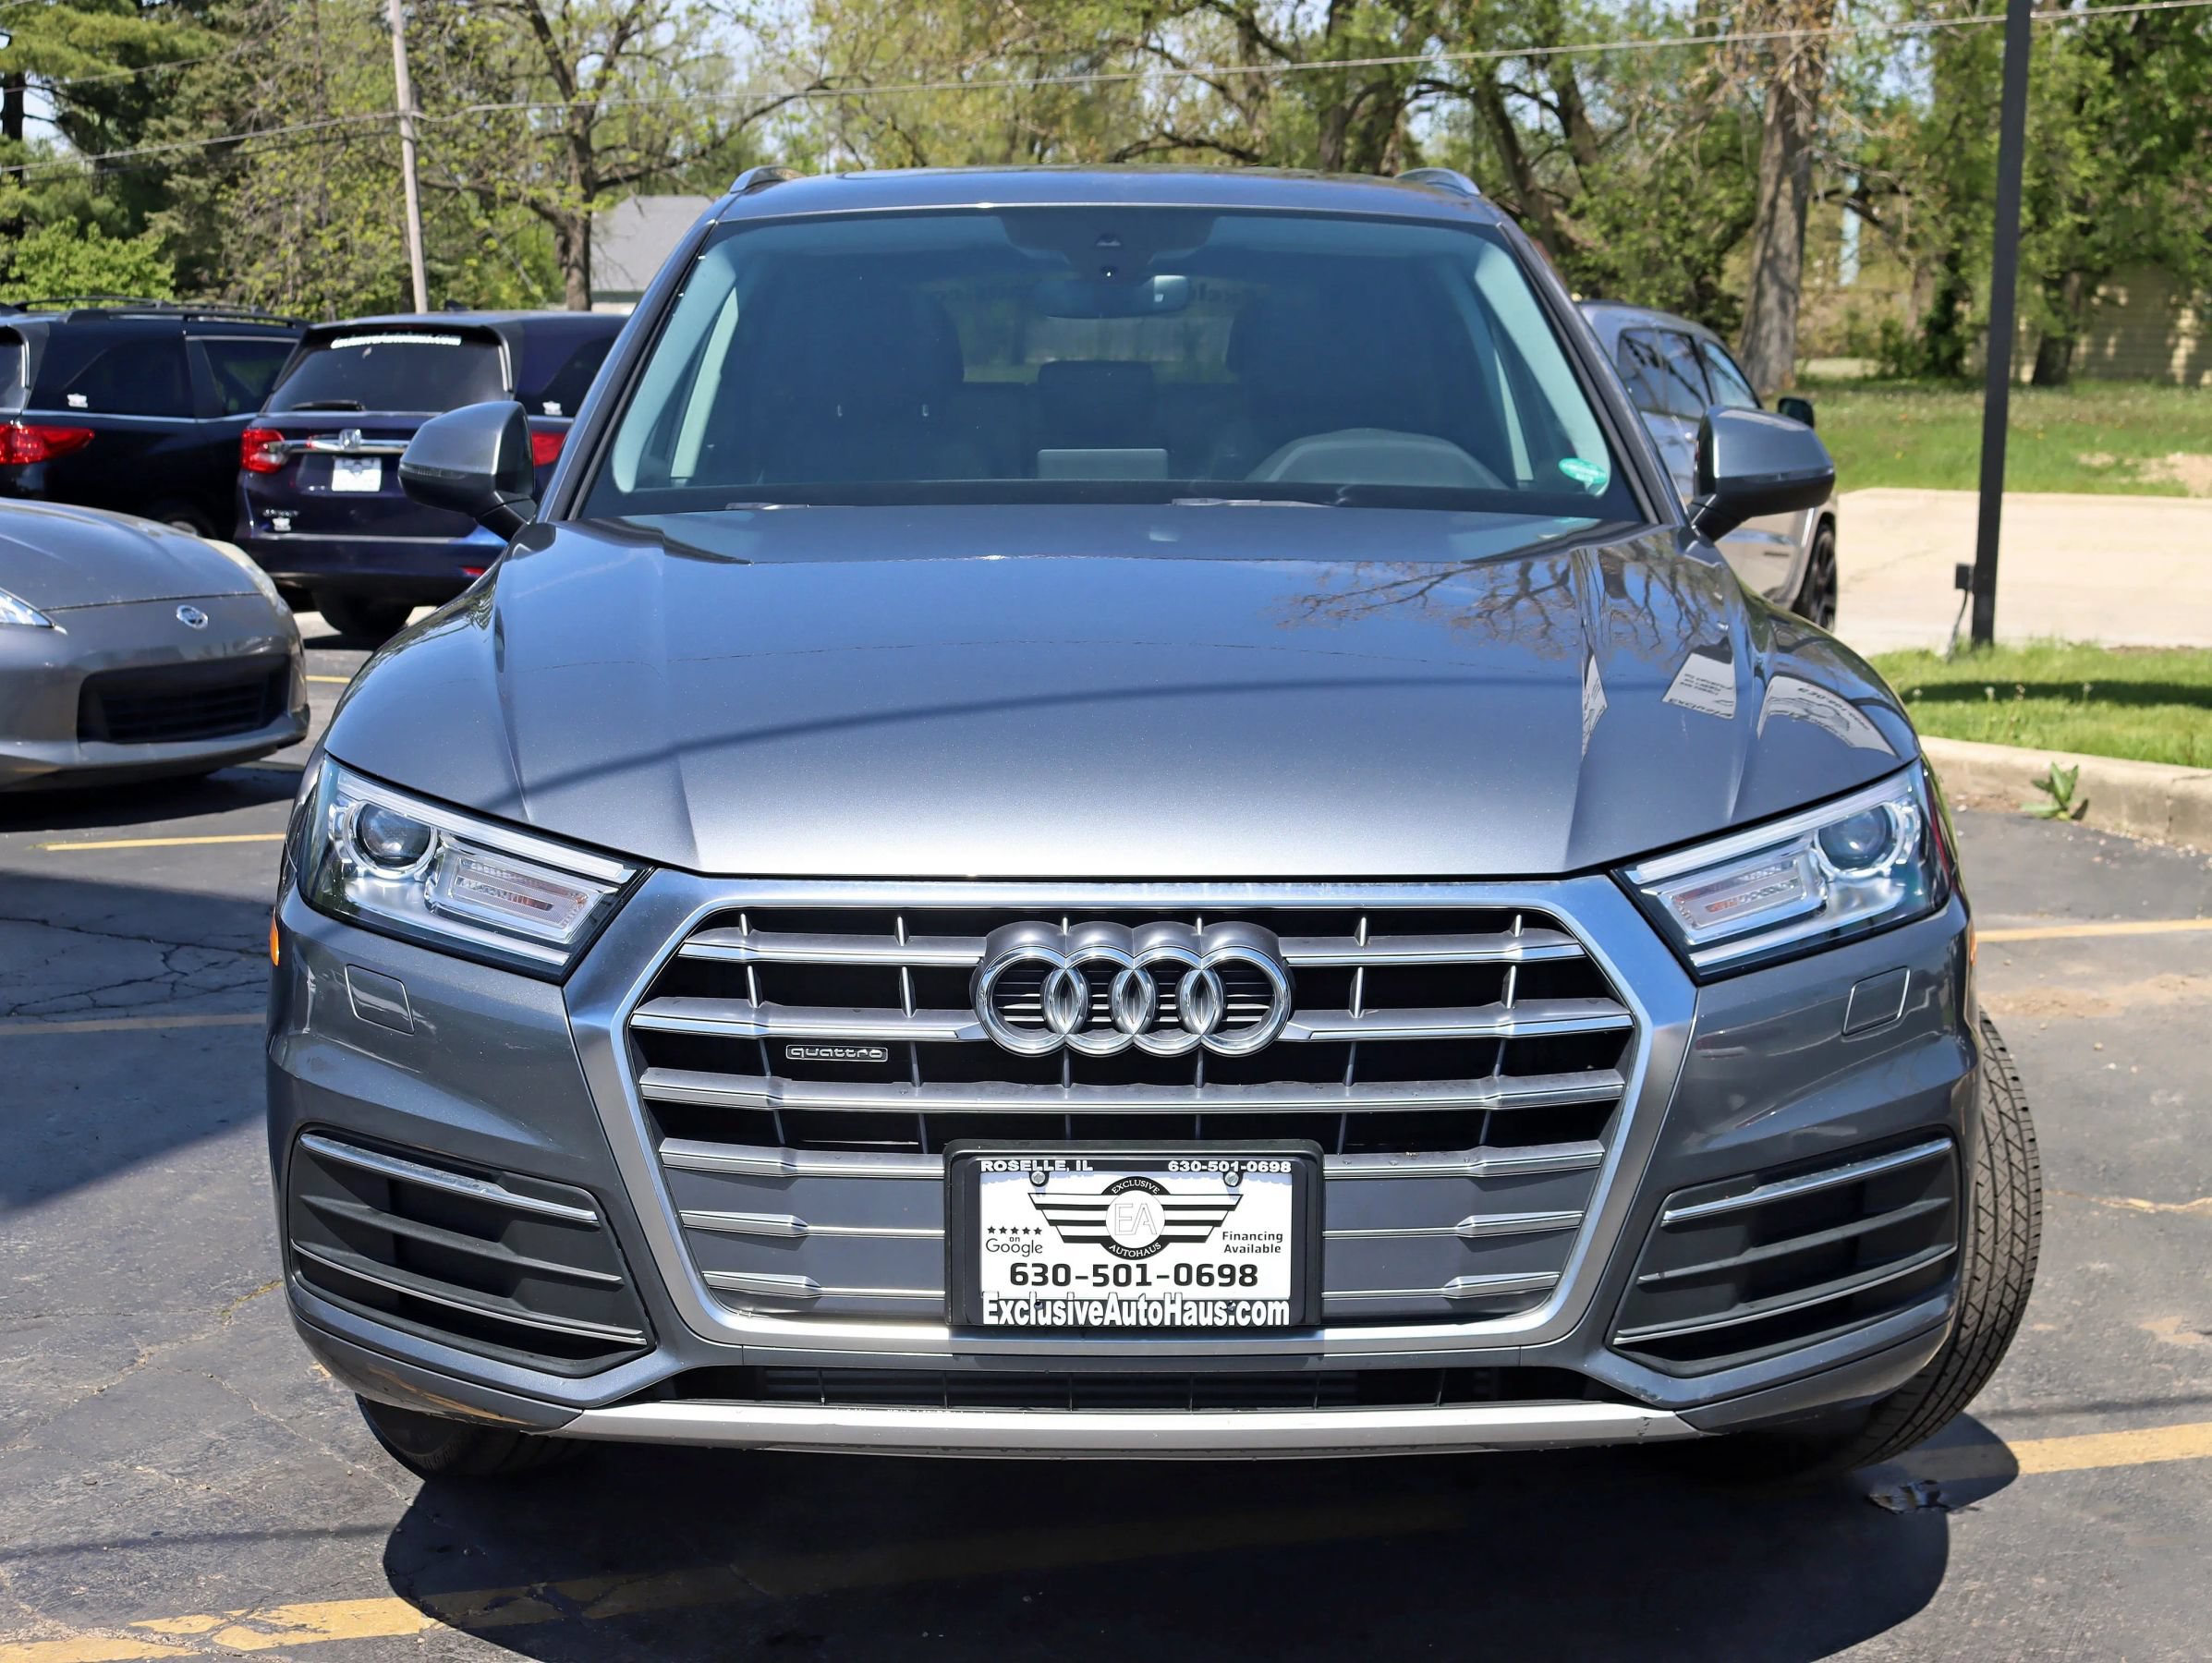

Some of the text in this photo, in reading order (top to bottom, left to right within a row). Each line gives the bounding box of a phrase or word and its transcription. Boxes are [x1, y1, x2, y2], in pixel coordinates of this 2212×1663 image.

[790, 1048, 883, 1059] quattro
[980, 1160, 1094, 1171] ROSELLE, IL
[1167, 1160, 1292, 1172] 630-501-0698
[1111, 1179, 1161, 1195] EXCLUSIVE
[1114, 1203, 1158, 1235] EA
[1222, 1231, 1283, 1244] Financing
[985, 1238, 1043, 1257] Google
[1109, 1242, 1161, 1257] AUTOHAUS
[1223, 1244, 1282, 1254] Available
[1010, 1262, 1258, 1287] 630-501-0698
[982, 1291, 1290, 1327] ExclusiveAutoHaus.com
